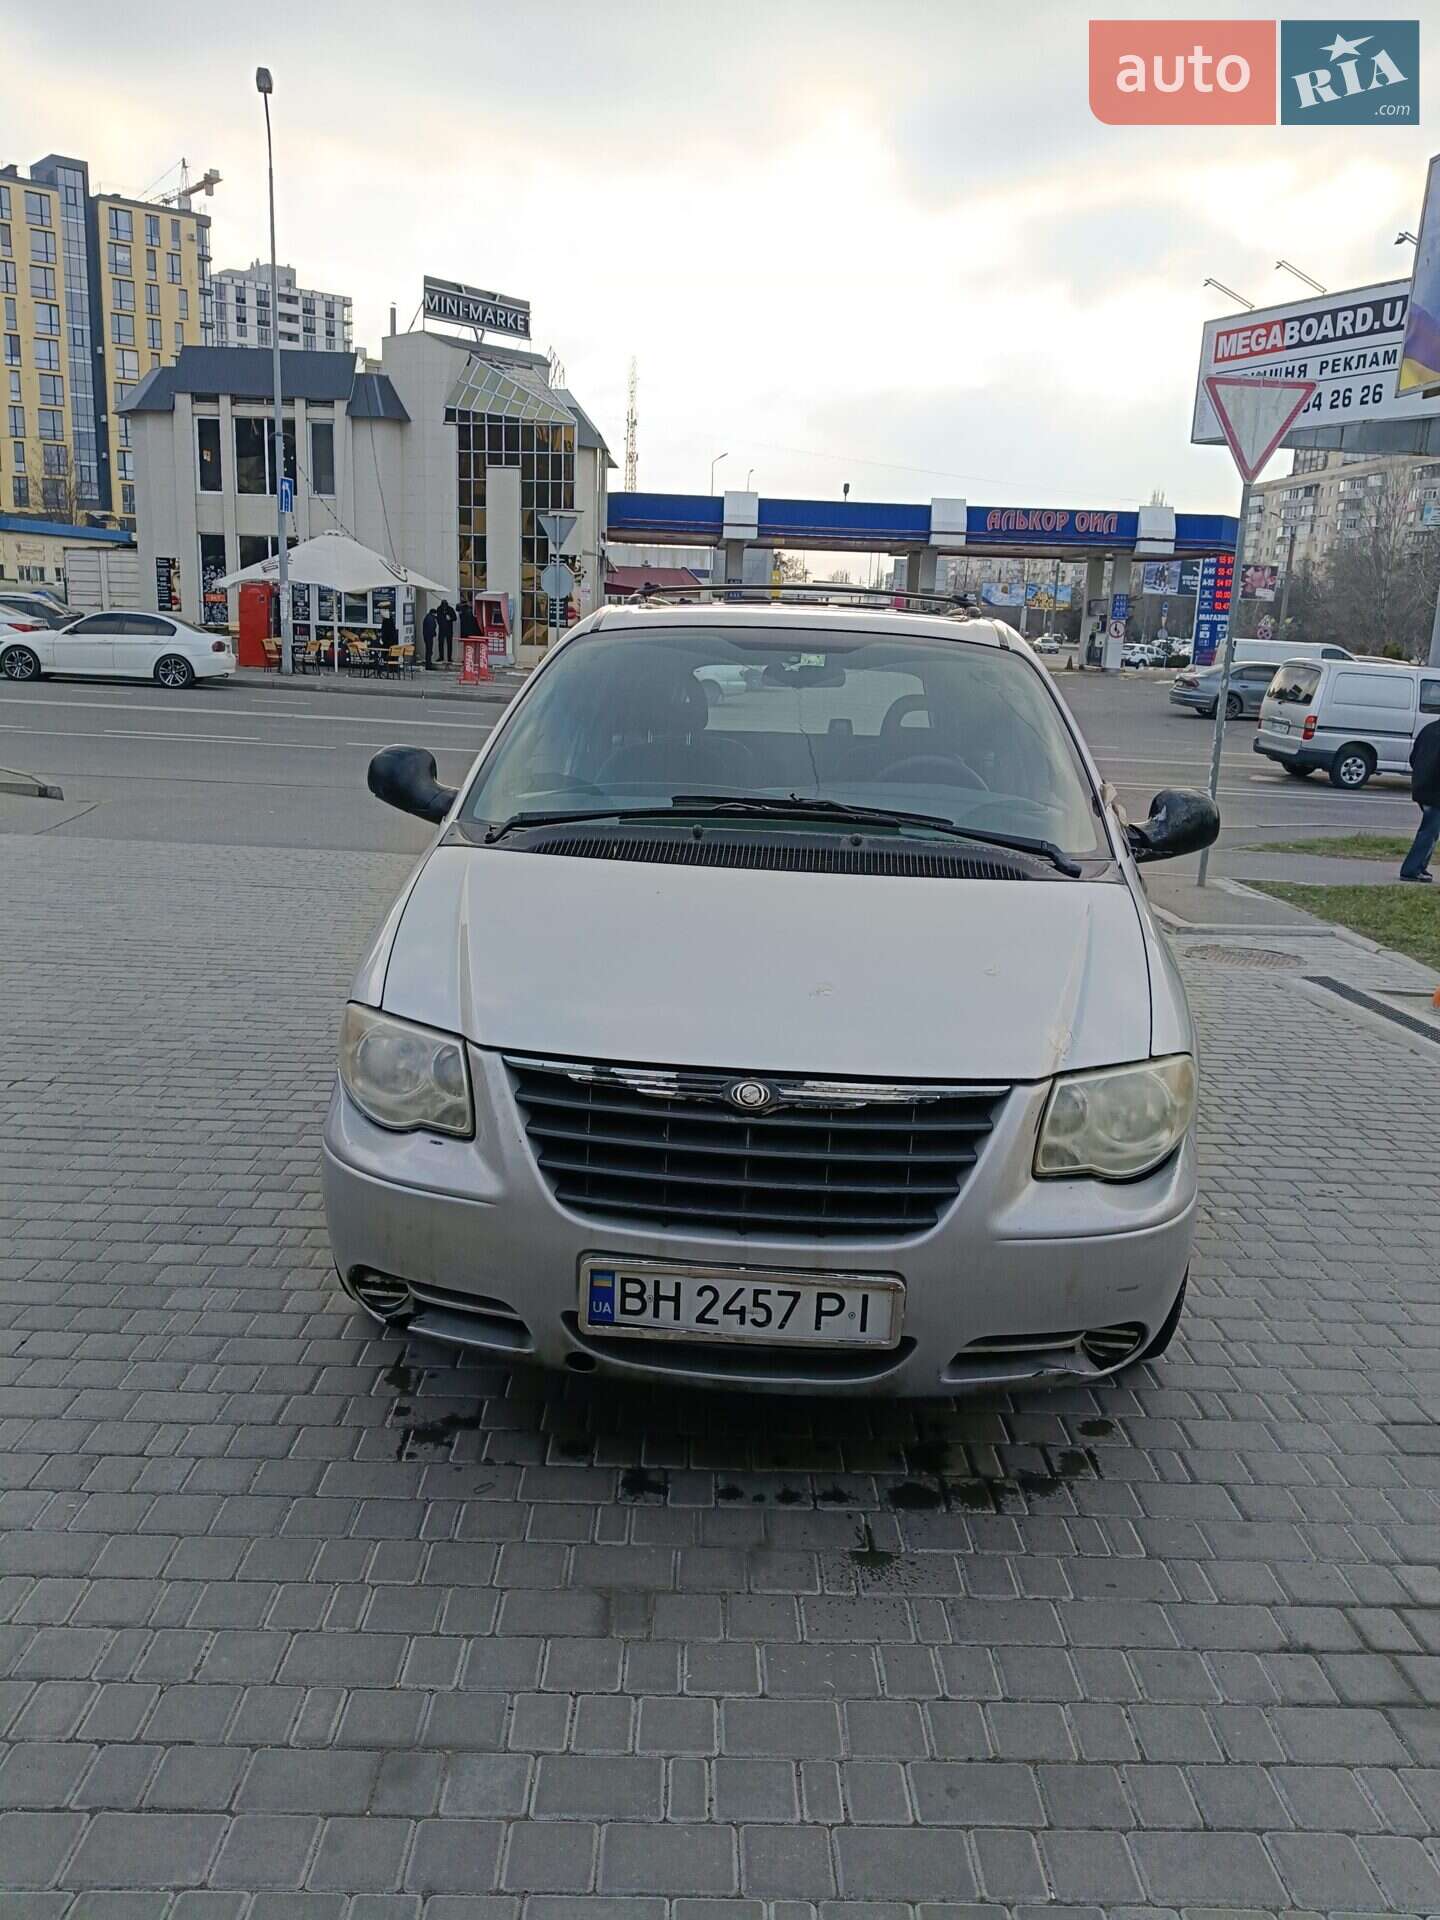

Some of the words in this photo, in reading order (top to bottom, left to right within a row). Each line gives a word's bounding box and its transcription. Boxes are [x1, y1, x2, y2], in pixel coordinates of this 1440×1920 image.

[1216, 300, 1408, 359] MEGABOARD.U
[1329, 387, 1353, 410] 26
[1359, 383, 1384, 406] 26
[986, 509, 1070, 532] АЛЬКОР
[1075, 511, 1119, 535] ОИЛ
[592, 1301, 613, 1315] UA
[618, 1276, 681, 1321] BH
[695, 1284, 801, 1331] 2457
